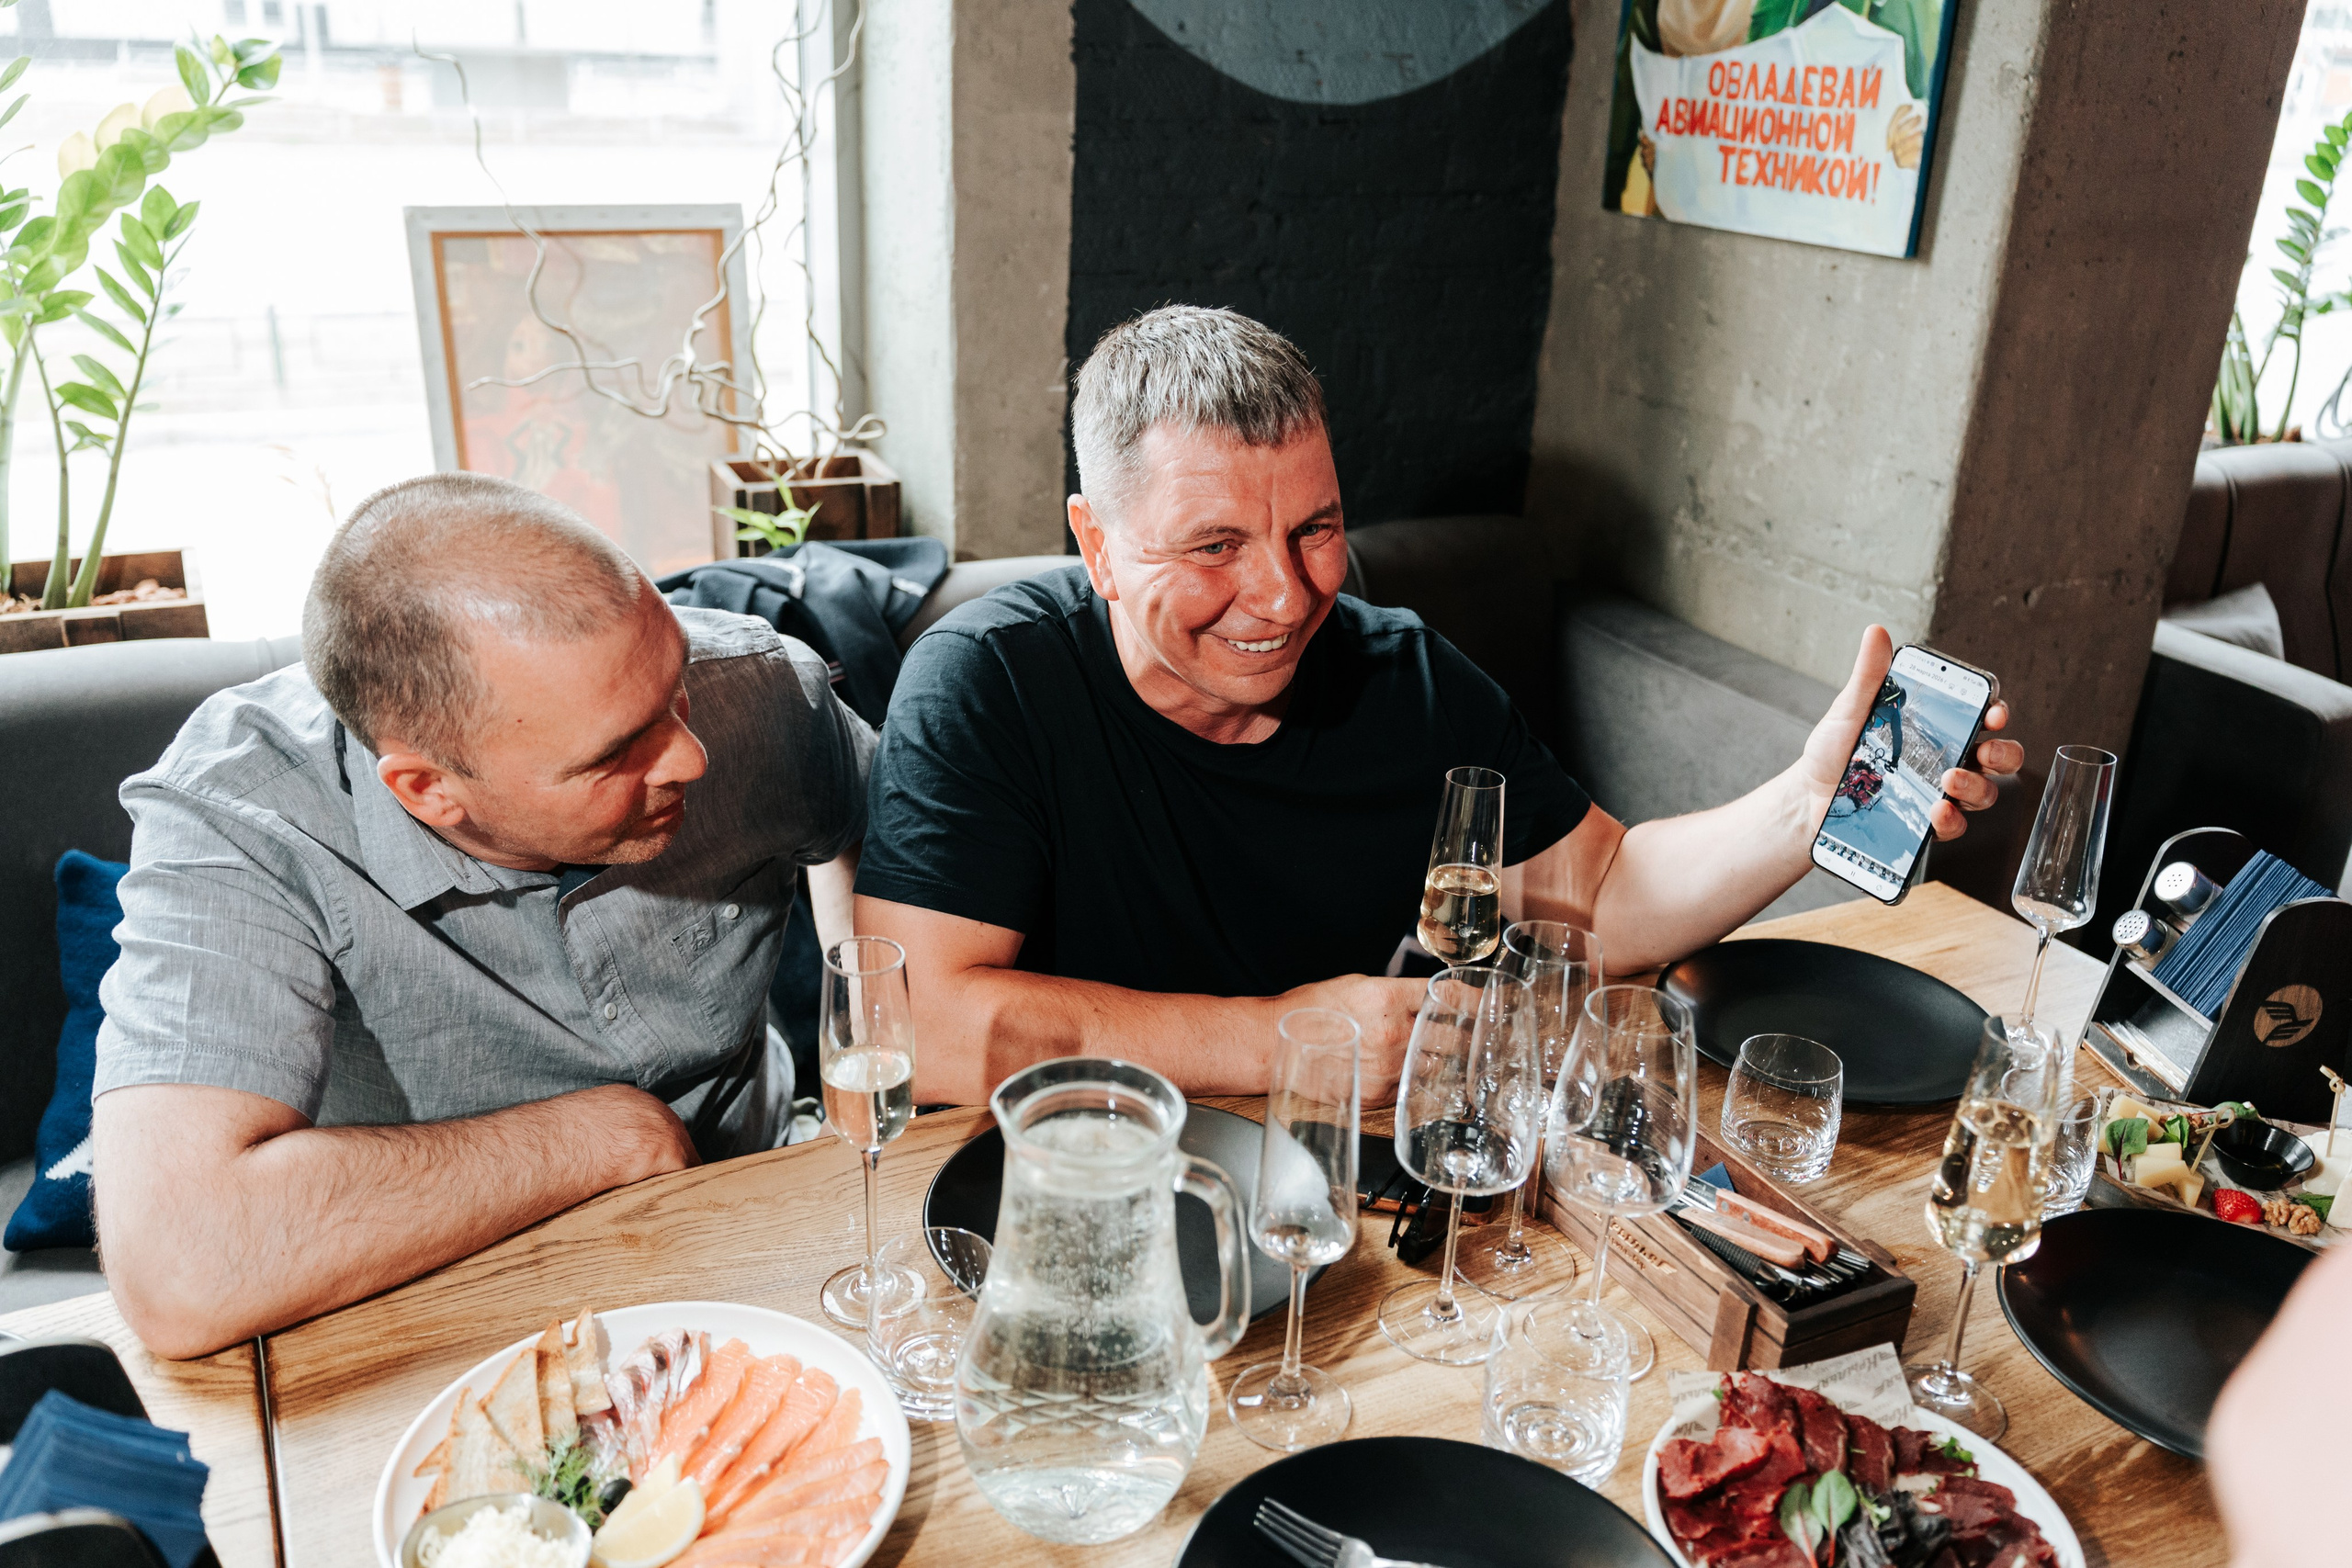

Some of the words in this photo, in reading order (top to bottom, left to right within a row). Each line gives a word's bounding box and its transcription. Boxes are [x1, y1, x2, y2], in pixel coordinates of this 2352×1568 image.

[1708, 61, 1883, 109] ОВЛАДЕВАЙ
[1656, 97, 1856, 154] АВИАЦИОННОЙ
[1718, 145, 1881, 205] ТЕХНИКОЙ!
